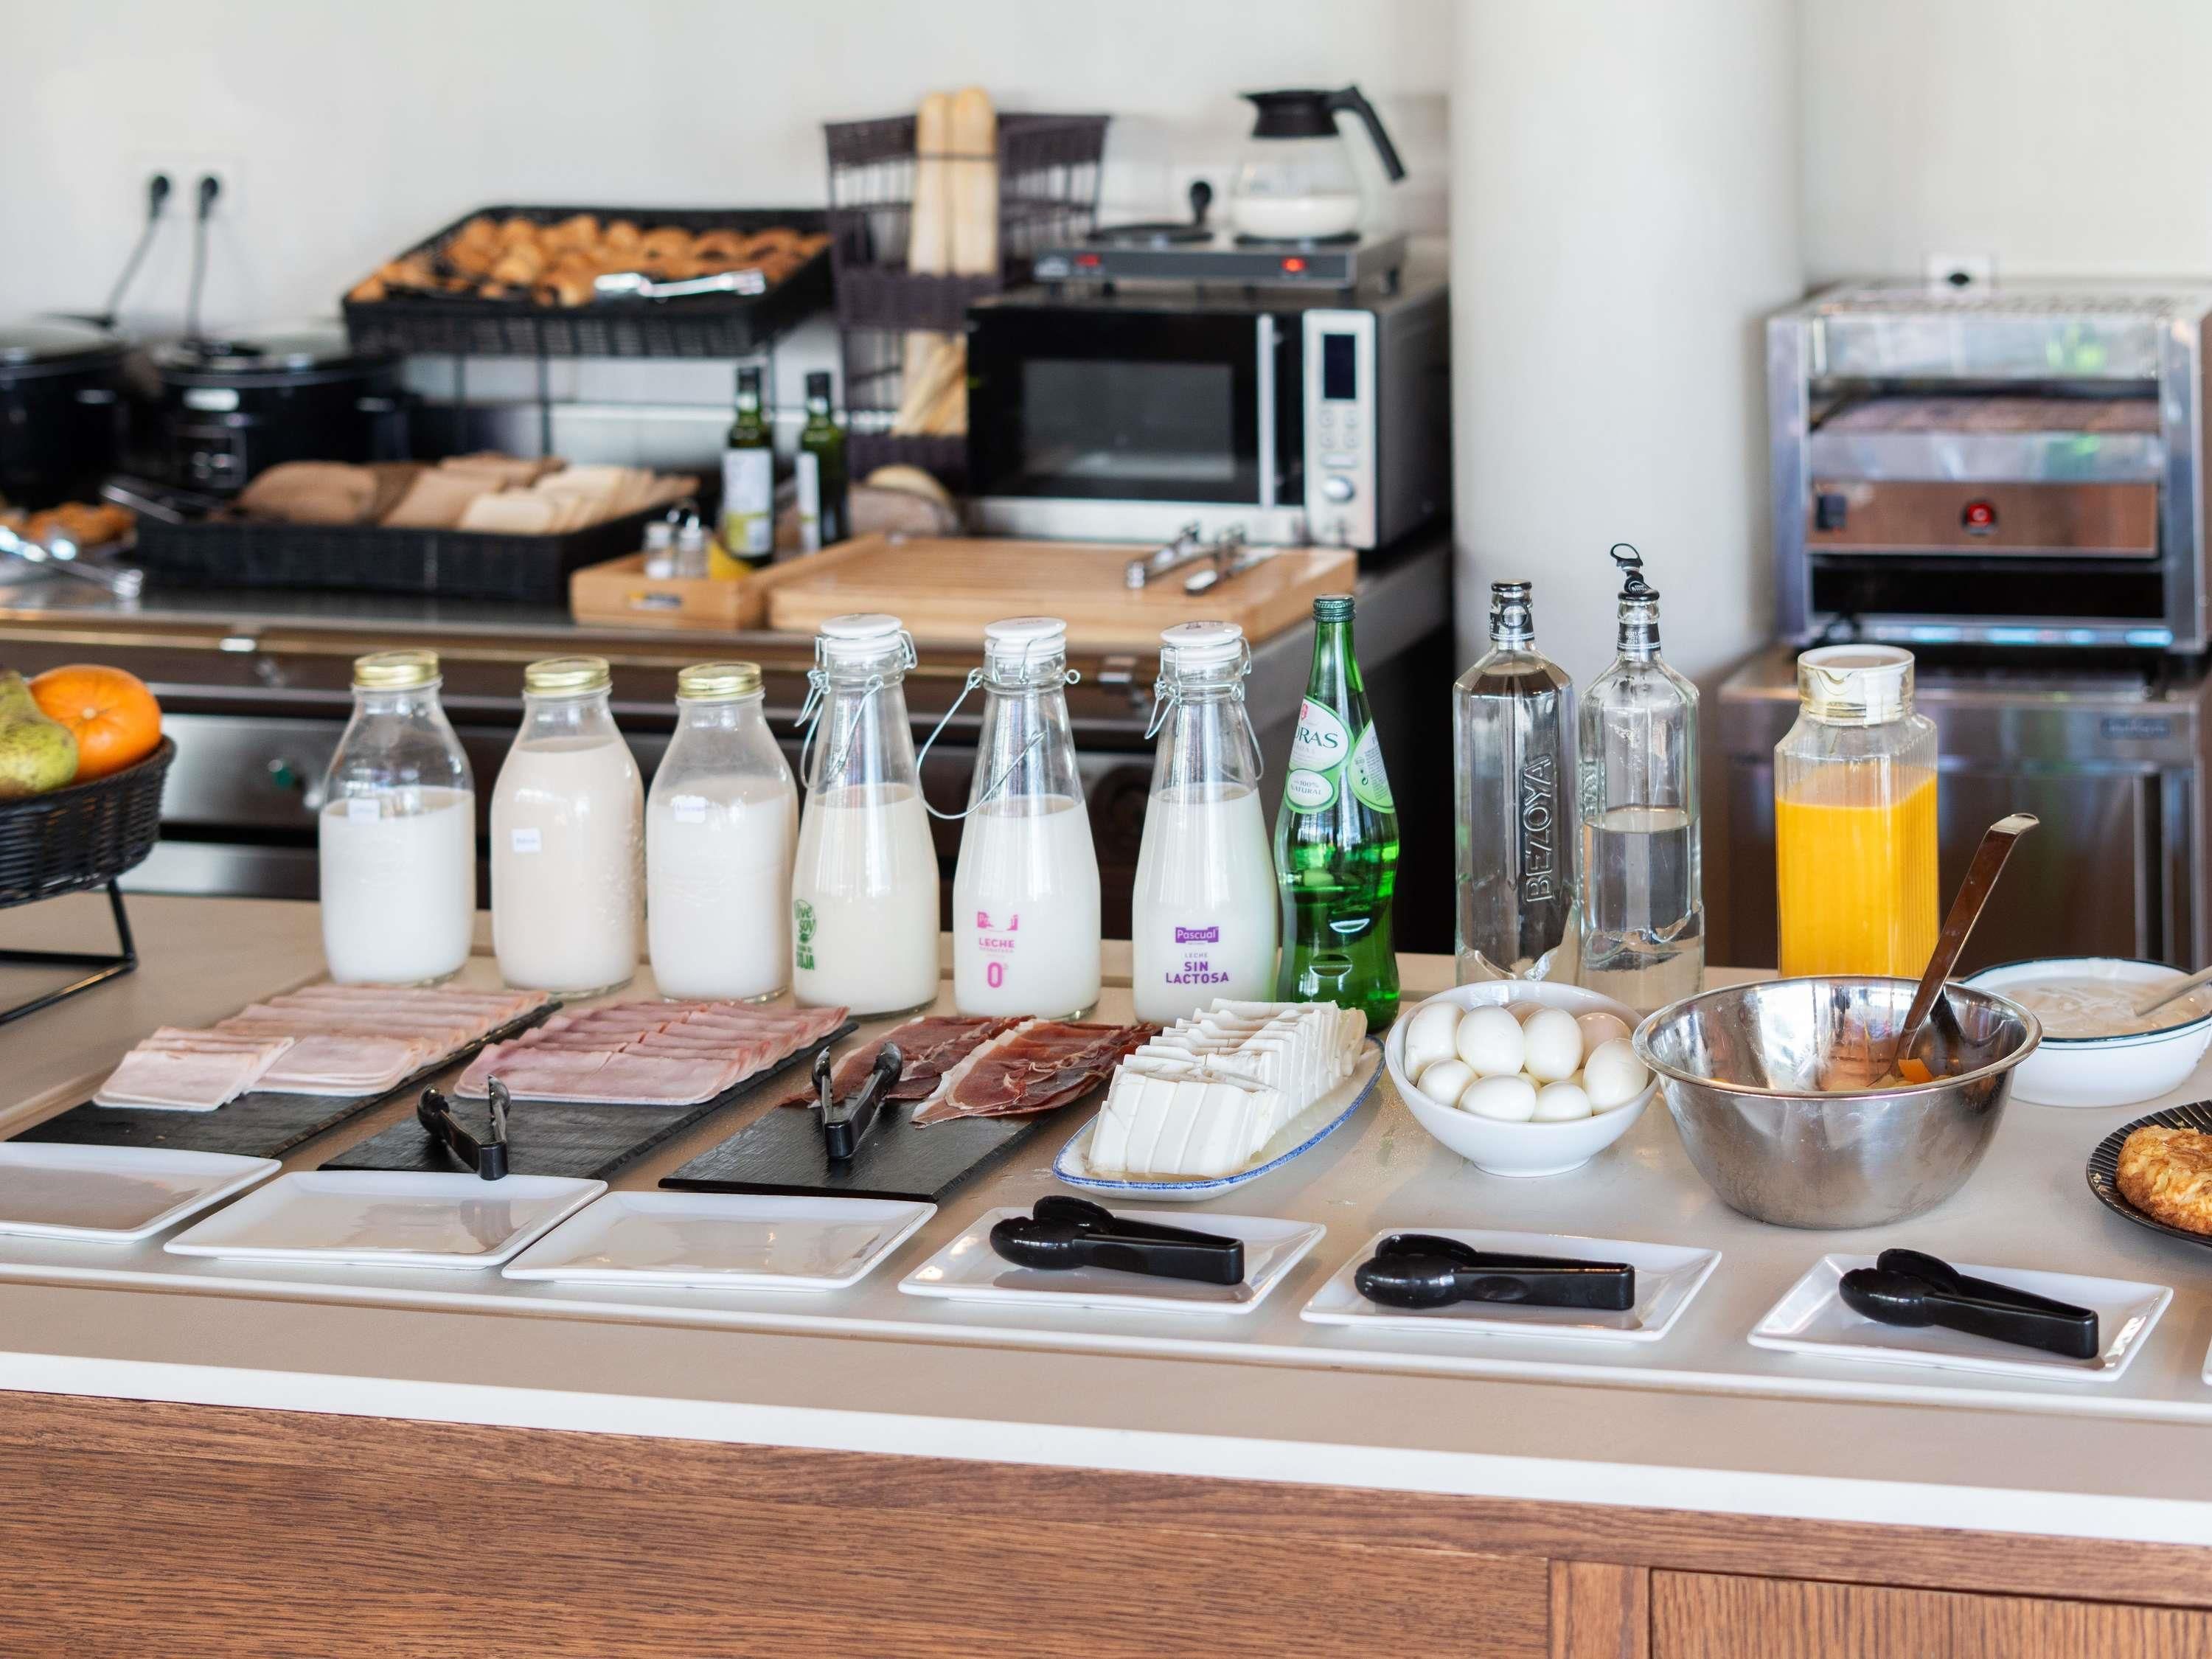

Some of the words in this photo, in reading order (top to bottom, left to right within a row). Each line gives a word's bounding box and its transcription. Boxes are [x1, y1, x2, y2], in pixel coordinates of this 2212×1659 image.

[1290, 784, 1322, 795] NATURAL
[1523, 757, 1553, 902] BEZOYA
[1177, 929, 1217, 939] Pascual
[978, 937, 1015, 949] LECHE
[1184, 961, 1208, 972] SIN
[1166, 972, 1229, 984] LACTOSA
